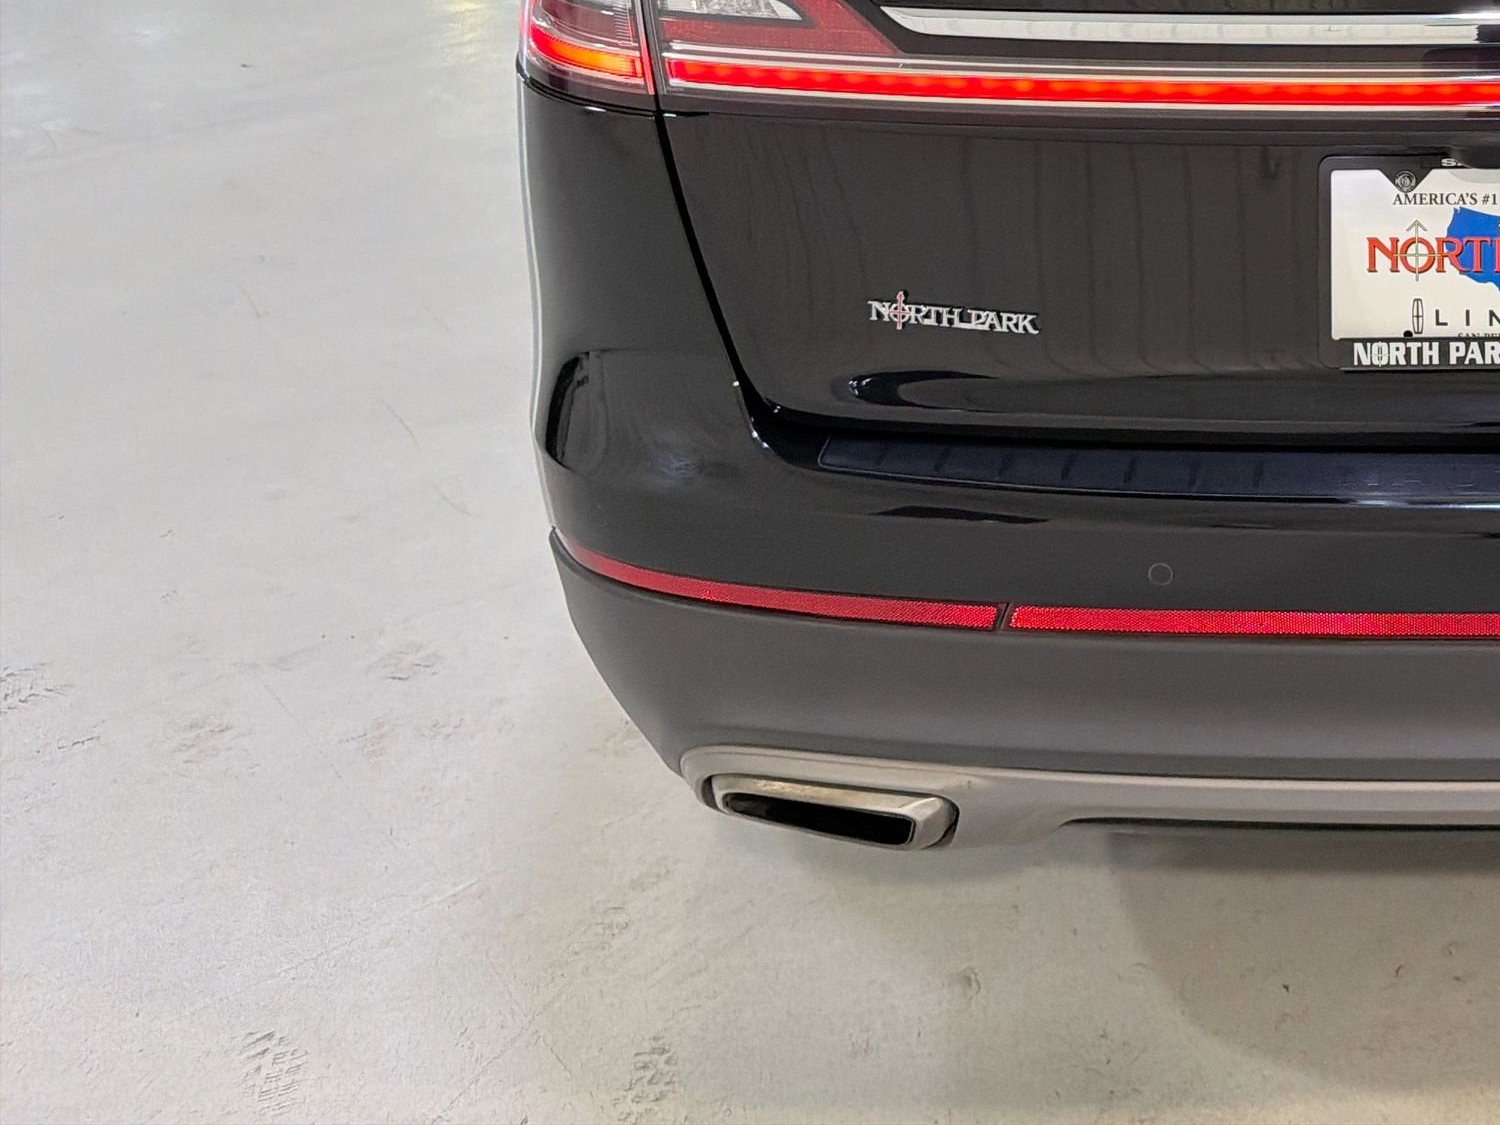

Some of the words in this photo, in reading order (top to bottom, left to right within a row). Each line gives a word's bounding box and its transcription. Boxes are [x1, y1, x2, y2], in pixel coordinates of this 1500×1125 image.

[1392, 192, 1478, 206] AMERICA'S
[1482, 193, 1498, 206] #1
[867, 300, 964, 328] NORTH
[967, 308, 1040, 335] PARK
[1353, 341, 1440, 366] NORTH
